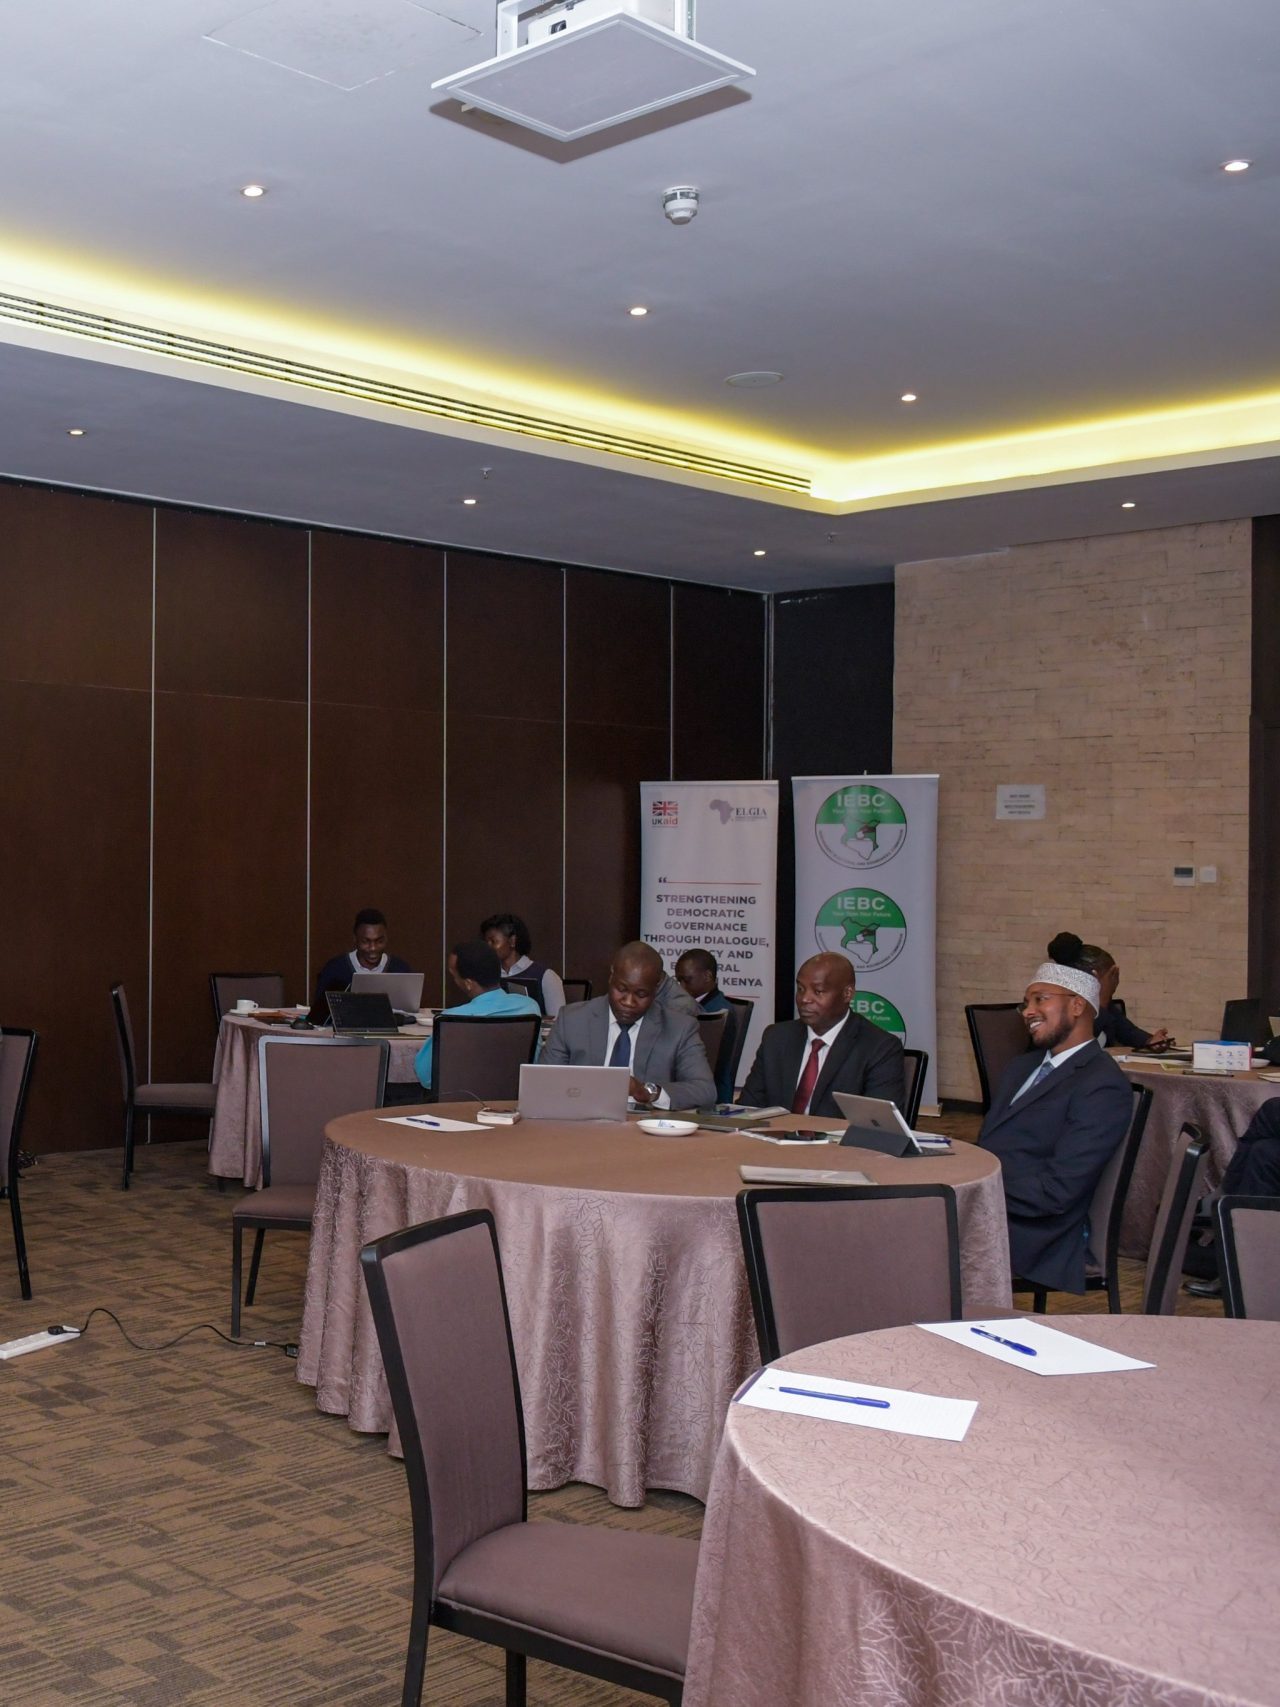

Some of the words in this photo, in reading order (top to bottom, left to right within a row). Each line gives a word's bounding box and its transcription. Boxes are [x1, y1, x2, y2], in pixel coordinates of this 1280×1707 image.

[836, 793, 887, 807] IEBC
[735, 807, 768, 816] ELGIA
[656, 894, 757, 905] STRENGTHENING
[836, 896, 886, 911] IEBC
[667, 907, 745, 918] DEMOCRATIC
[664, 921, 748, 932] GOVERNANCE
[644, 934, 701, 944] THROUGH
[704, 936, 769, 948] DIALOGUE,
[727, 951, 754, 959] AND
[722, 977, 763, 987] KENYA
